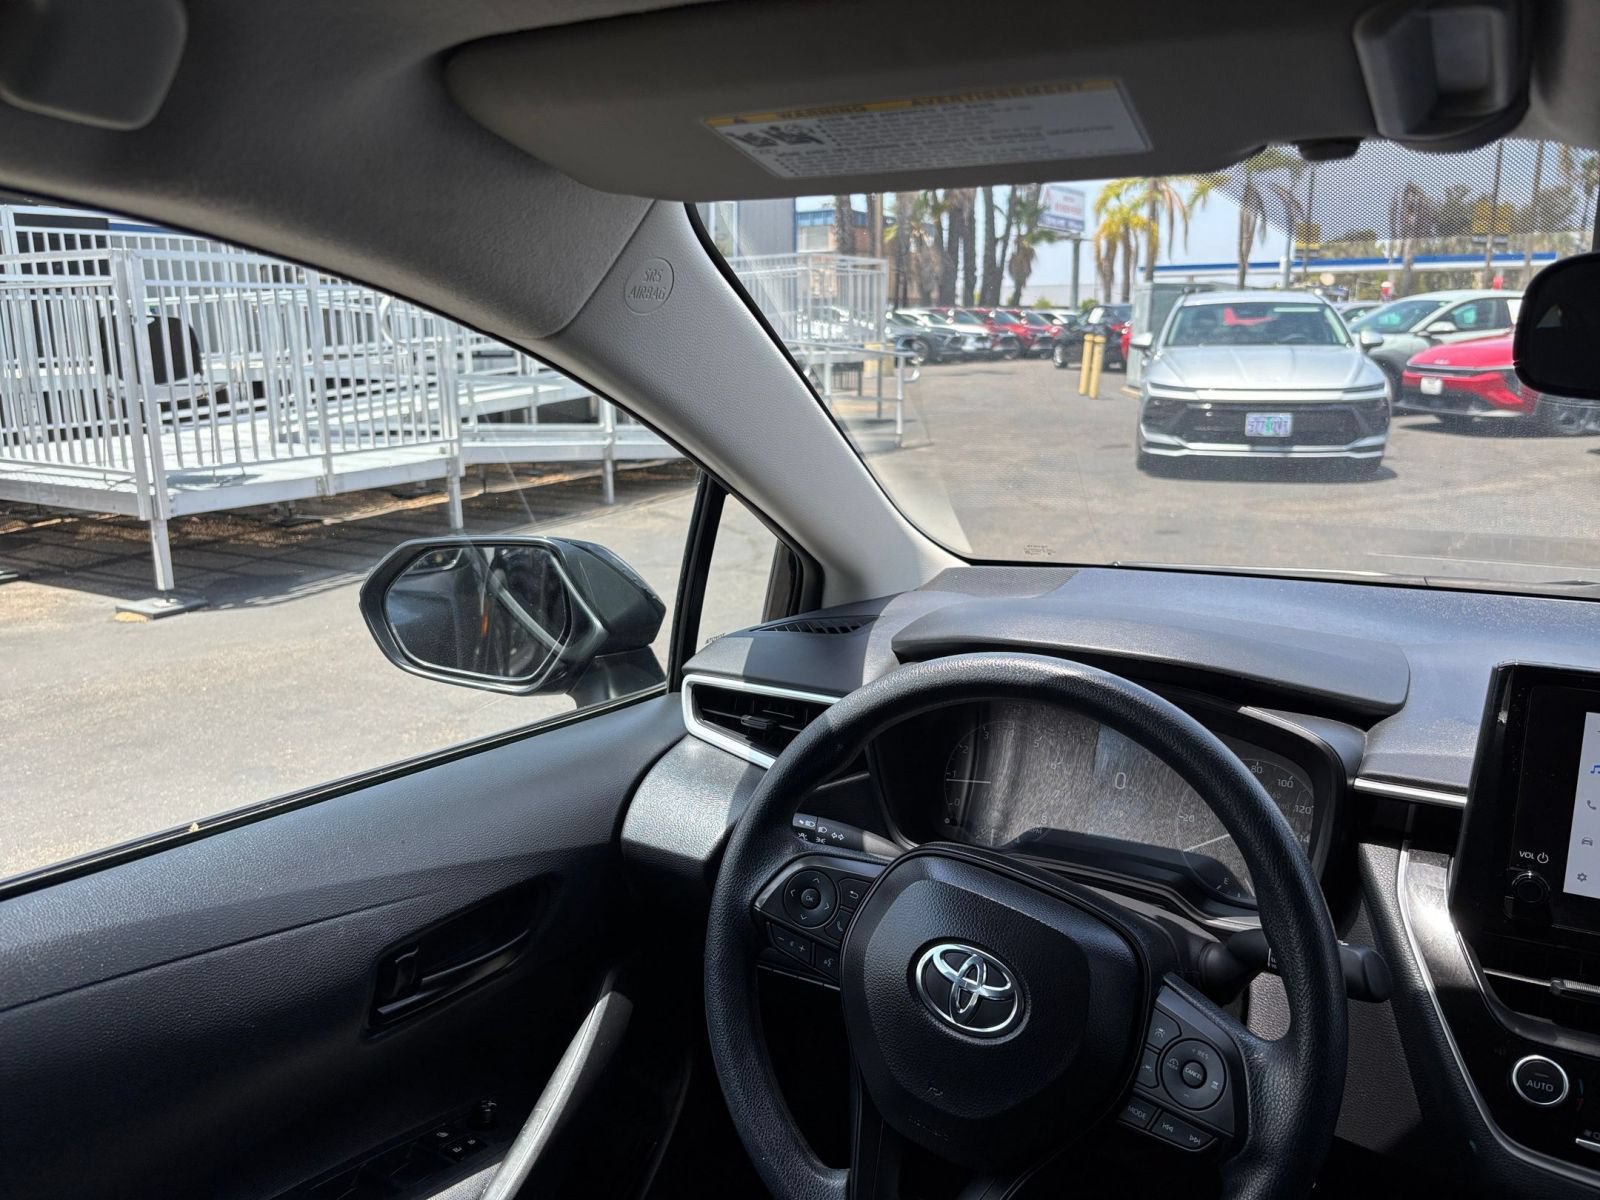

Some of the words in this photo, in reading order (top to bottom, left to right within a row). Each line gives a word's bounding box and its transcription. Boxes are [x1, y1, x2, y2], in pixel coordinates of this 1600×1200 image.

[642, 268, 663, 282] SRS
[628, 286, 667, 301] AIRBAG
[1251, 765, 1263, 774] 80
[1114, 772, 1127, 790] 0
[1276, 778, 1294, 788] 100
[1294, 804, 1311, 815] 120
[1182, 813, 1194, 823] 20
[1519, 850, 1534, 860] VOL
[1184, 1067, 1202, 1080] CANCEL
[1526, 1080, 1554, 1092] AUTO
[1127, 1104, 1147, 1120] MODE
